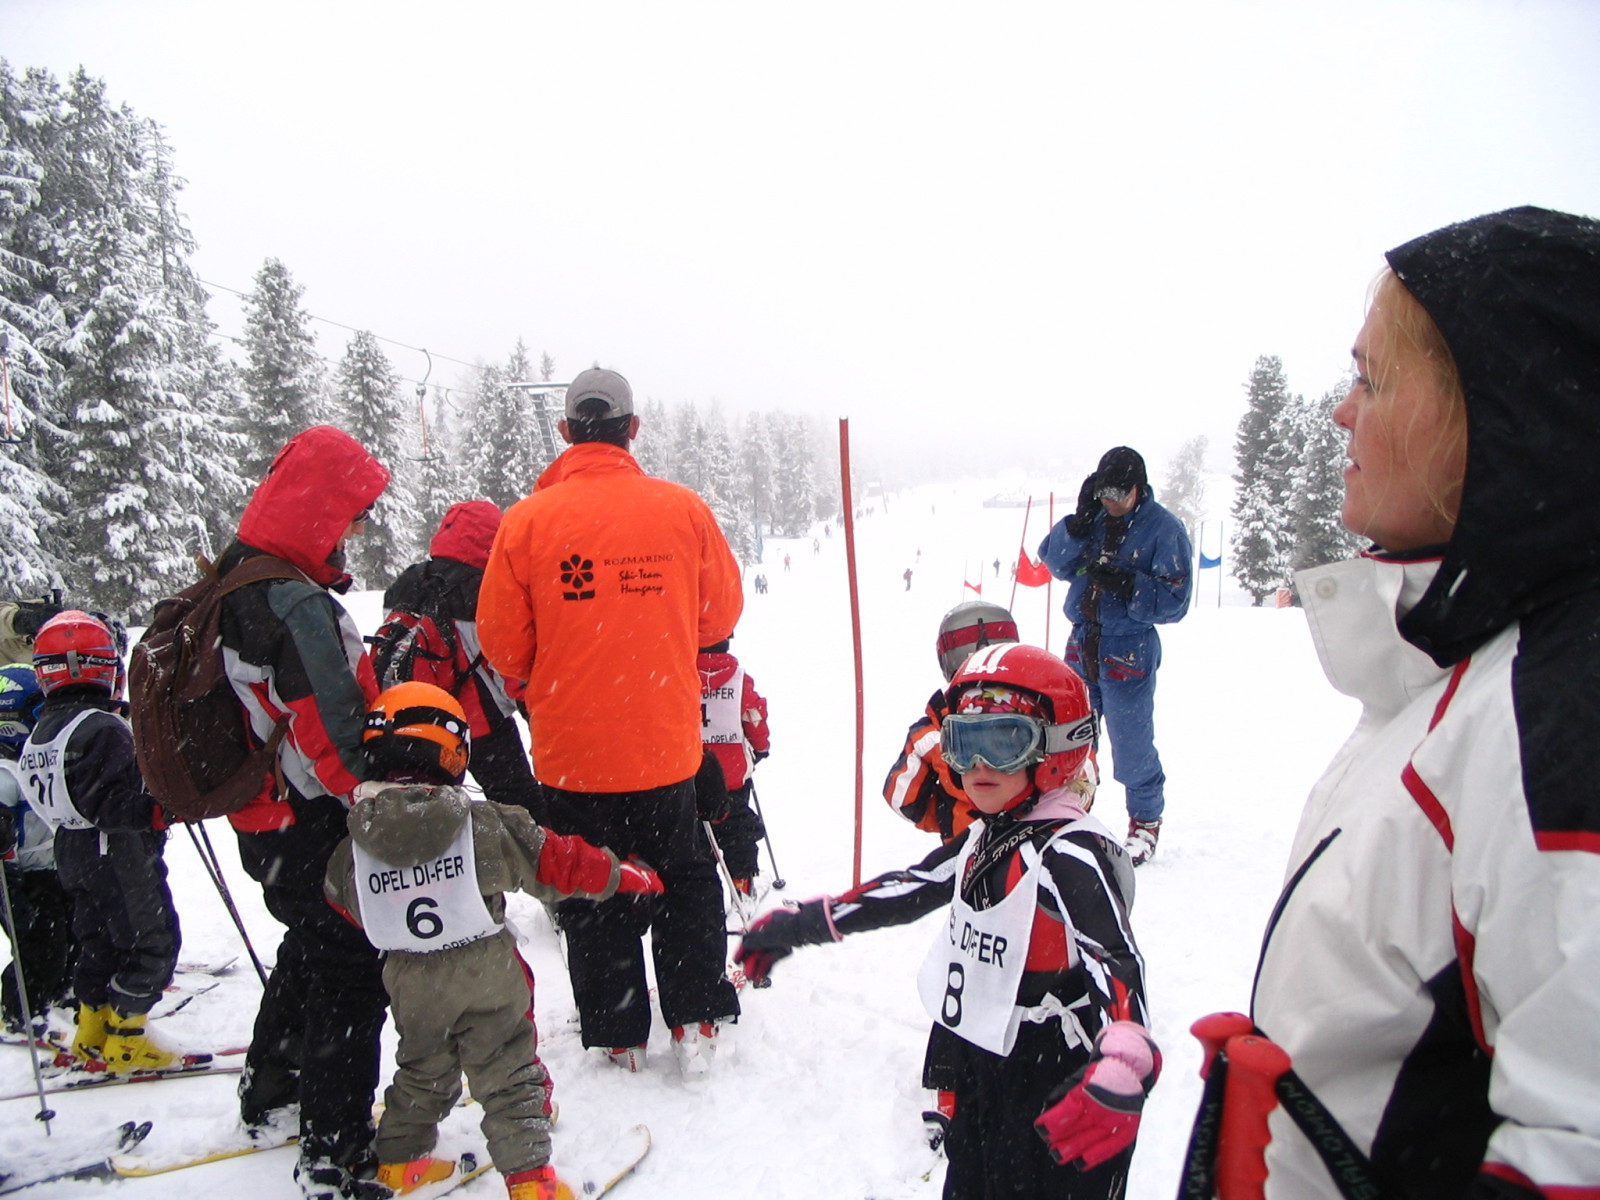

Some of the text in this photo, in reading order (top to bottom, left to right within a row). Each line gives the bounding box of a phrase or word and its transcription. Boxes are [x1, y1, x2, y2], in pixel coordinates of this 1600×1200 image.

[618, 569, 663, 582] Ski-Team
[620, 584, 663, 597] Hungary
[992, 825, 1034, 863] SPYDER
[368, 855, 465, 895] OPEL DI-FER
[405, 896, 444, 940] 6
[941, 962, 965, 1028] 8
